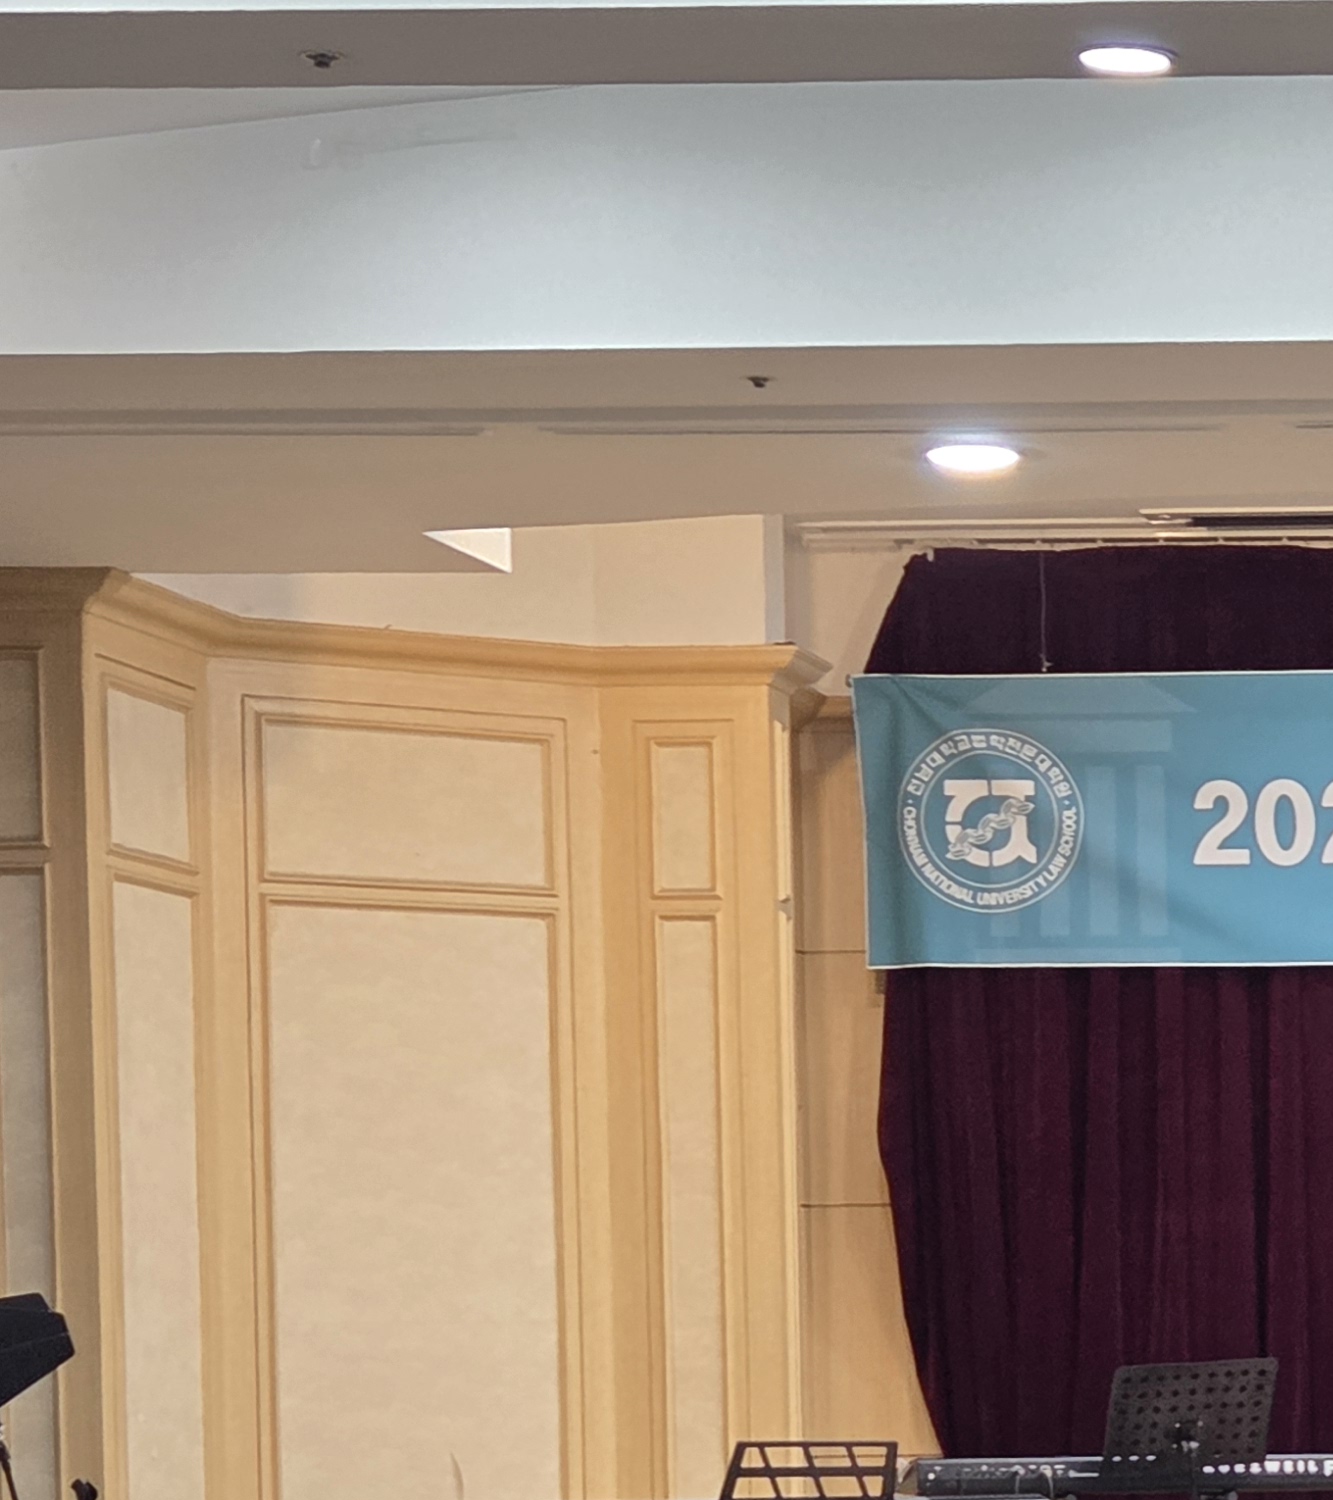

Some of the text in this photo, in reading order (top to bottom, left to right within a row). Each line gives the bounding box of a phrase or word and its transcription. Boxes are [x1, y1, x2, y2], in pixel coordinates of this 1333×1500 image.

[921, 862, 975, 904] NATIONAL
[976, 878, 1047, 905] UNIVERSITY
[1043, 856, 1068, 881] LAW
[1059, 807, 1078, 857] SCHOOL
